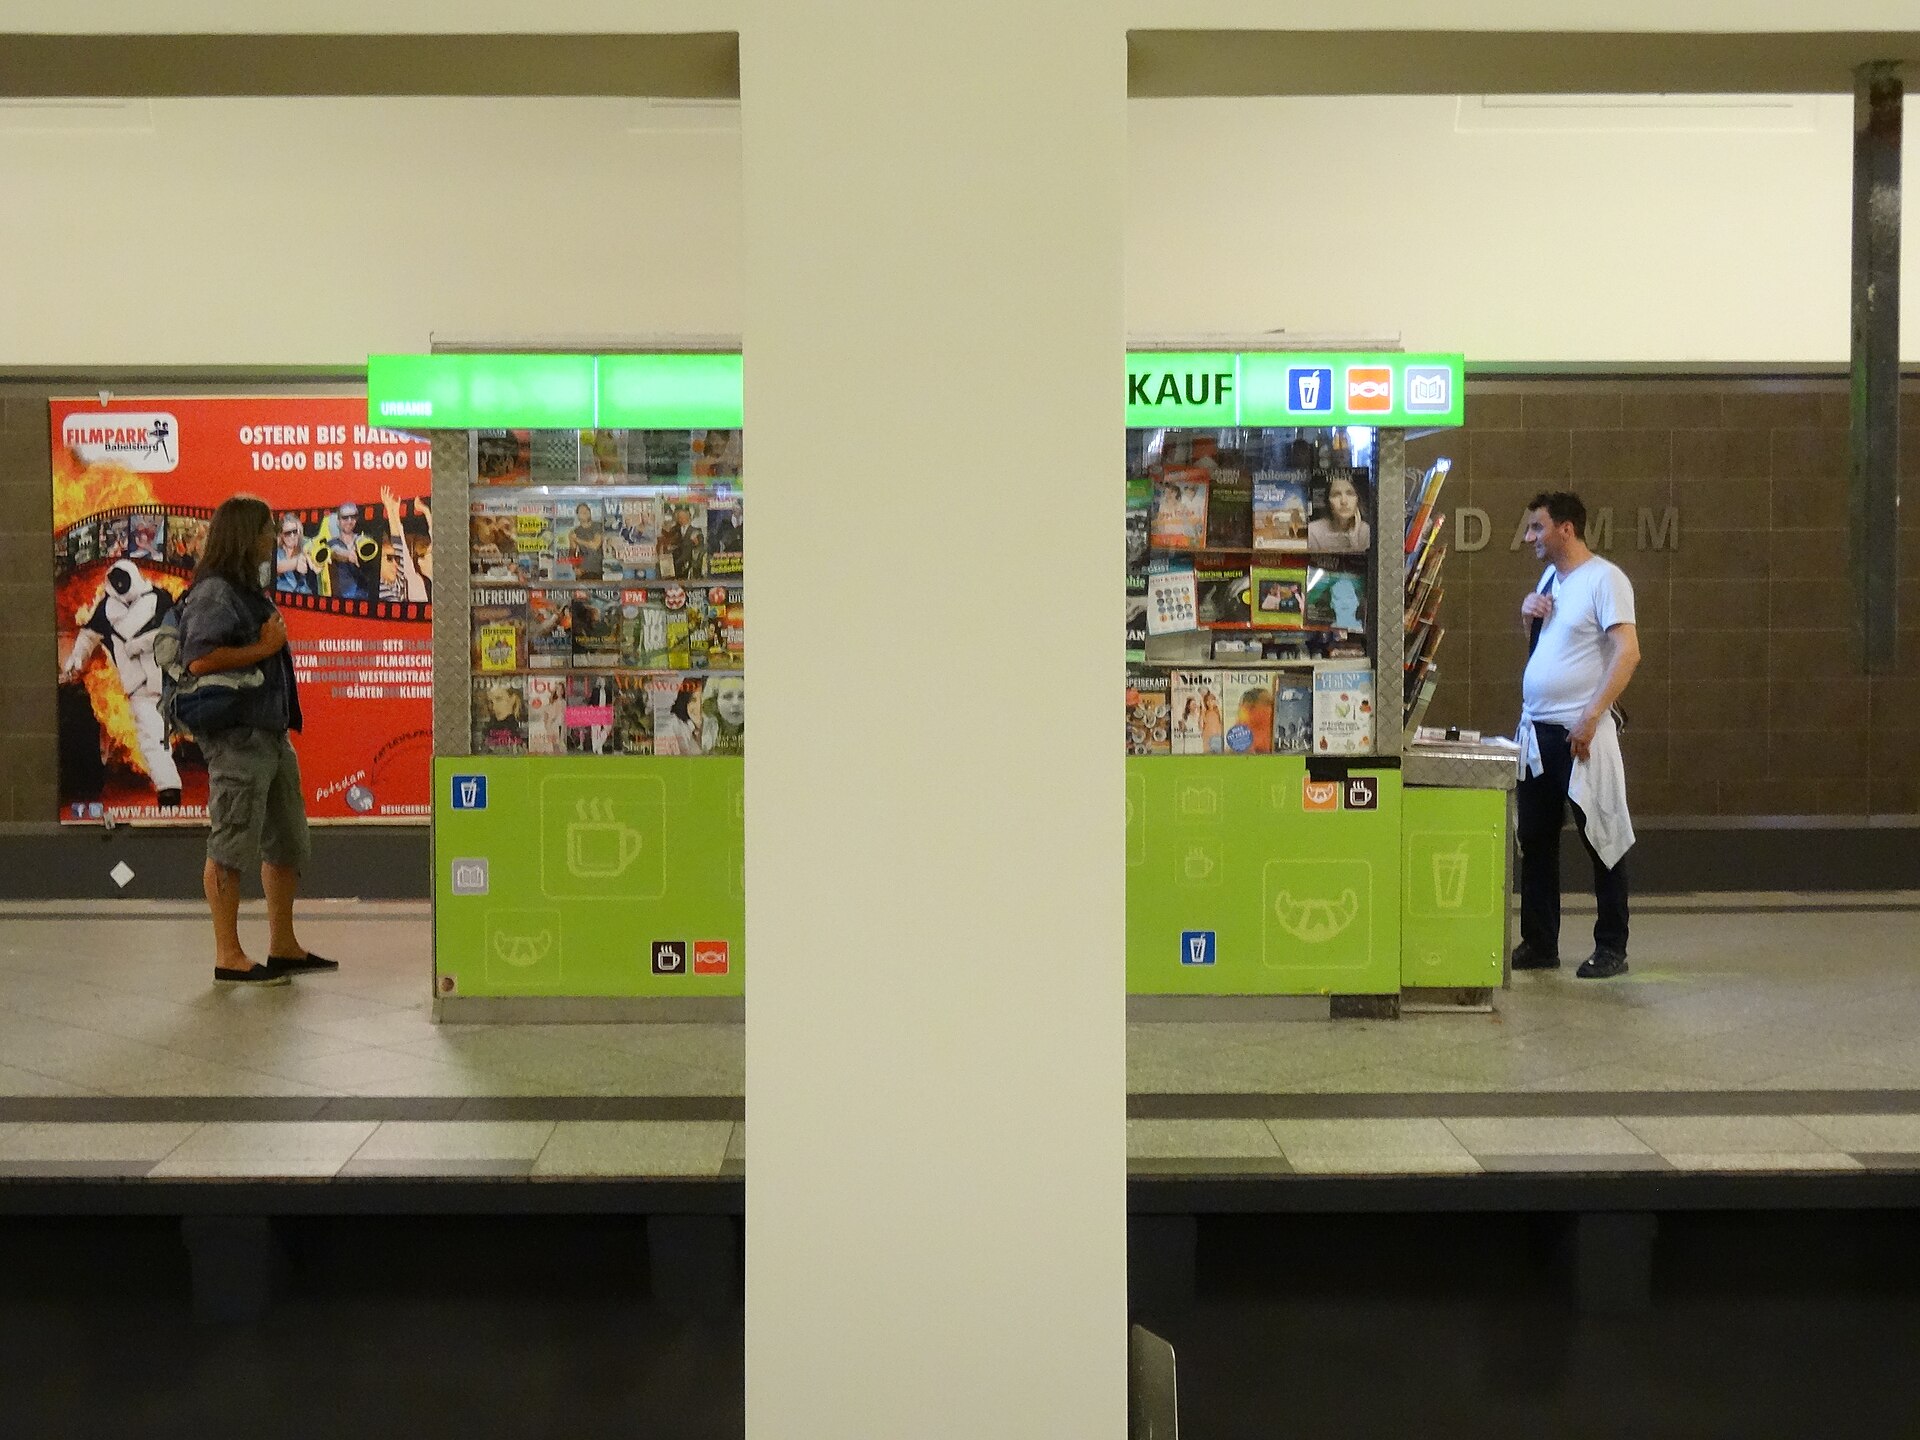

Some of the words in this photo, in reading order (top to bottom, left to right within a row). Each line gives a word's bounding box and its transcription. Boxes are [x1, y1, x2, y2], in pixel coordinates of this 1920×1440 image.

[1128, 373, 1232, 405] KAUF
[66, 429, 148, 444] FILMPARK
[239, 425, 310, 445] OSTERN
[317, 425, 346, 445] BIS
[251, 451, 307, 471] 10:00
[313, 451, 344, 471] BIS
[353, 450, 408, 470] 18:00
[1230, 672, 1269, 685] NEON
[316, 769, 366, 802] Potsdam
